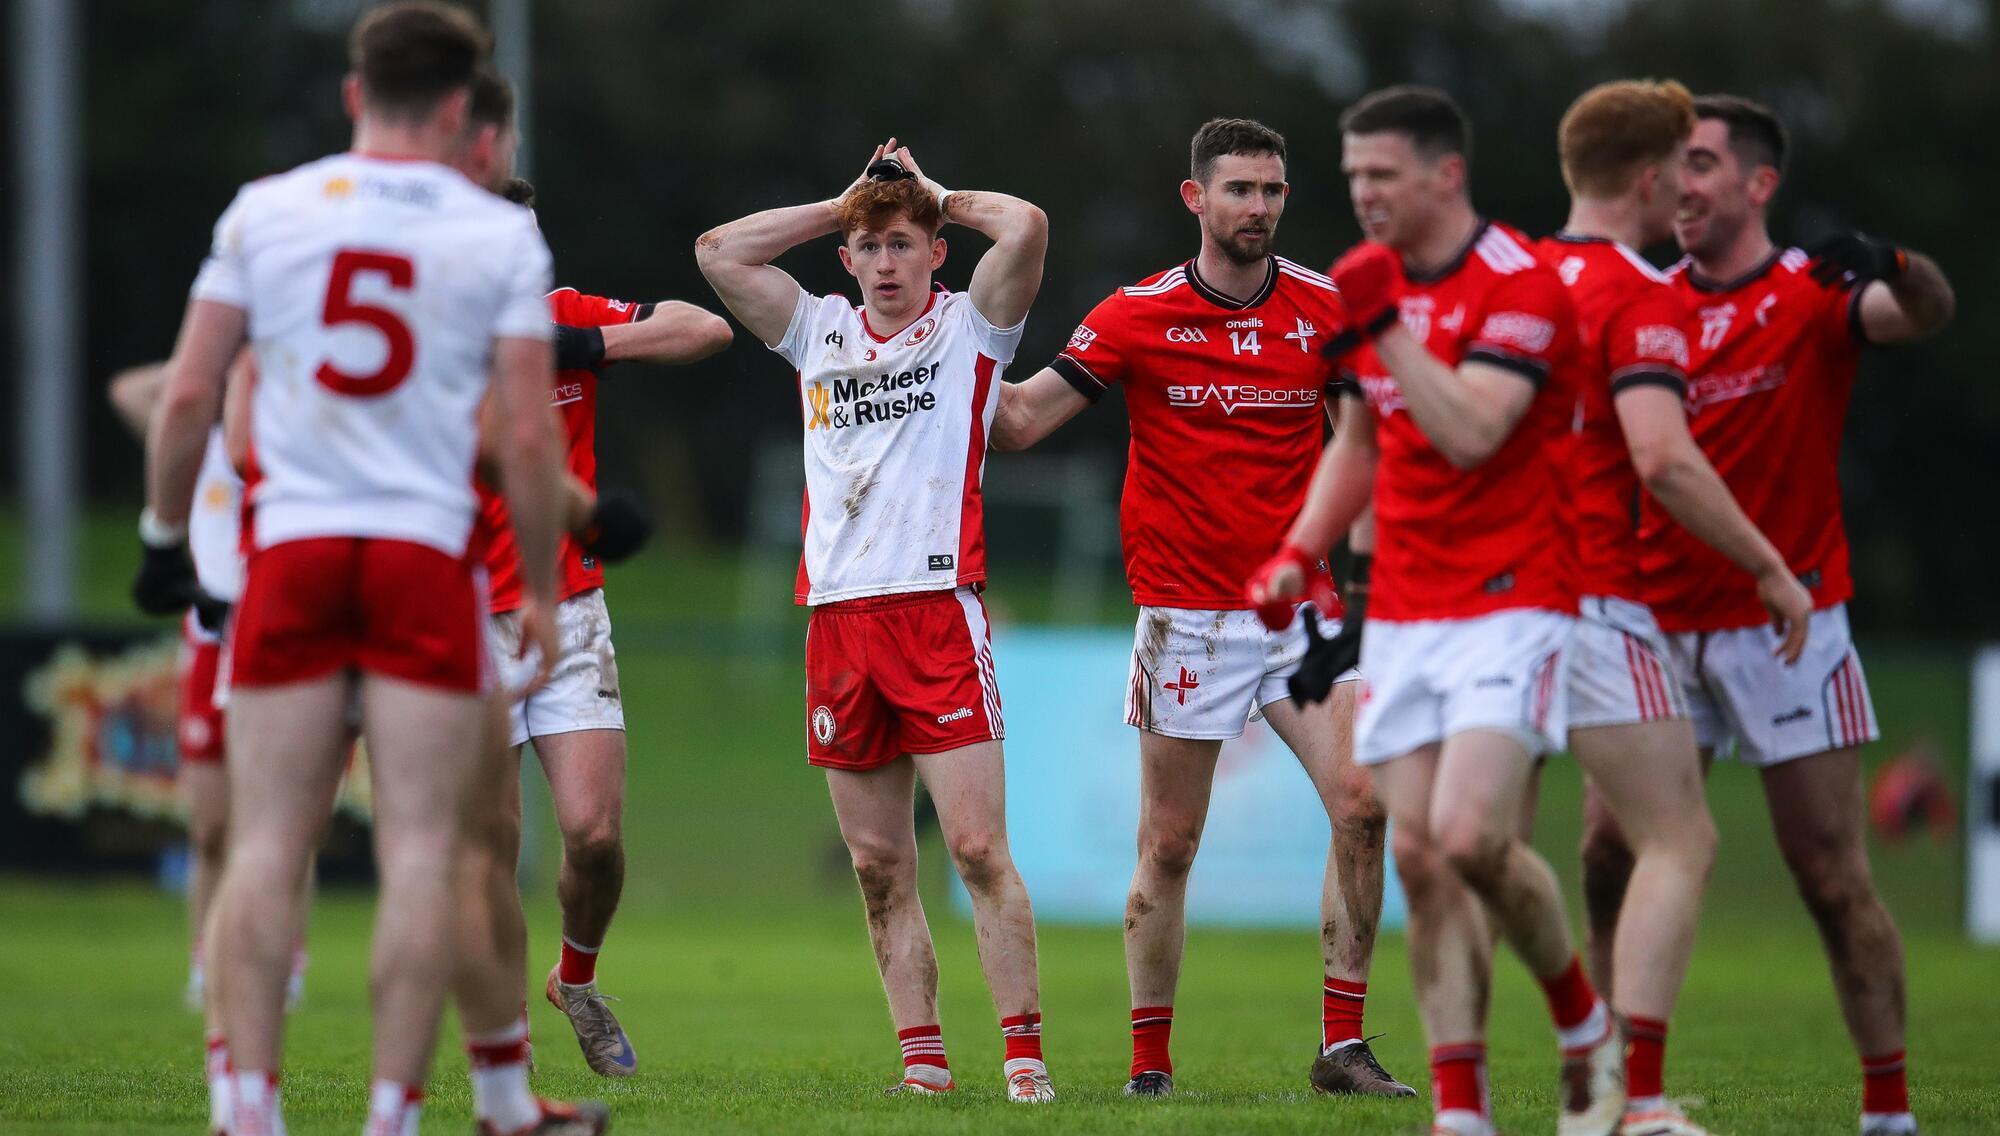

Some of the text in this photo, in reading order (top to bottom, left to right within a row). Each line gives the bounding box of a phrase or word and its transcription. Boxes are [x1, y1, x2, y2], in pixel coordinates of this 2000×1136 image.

[315, 248, 416, 398] 5
[1228, 330, 1262, 356] 14
[833, 361, 940, 403] McAleer
[833, 391, 936, 429] & Rushe
